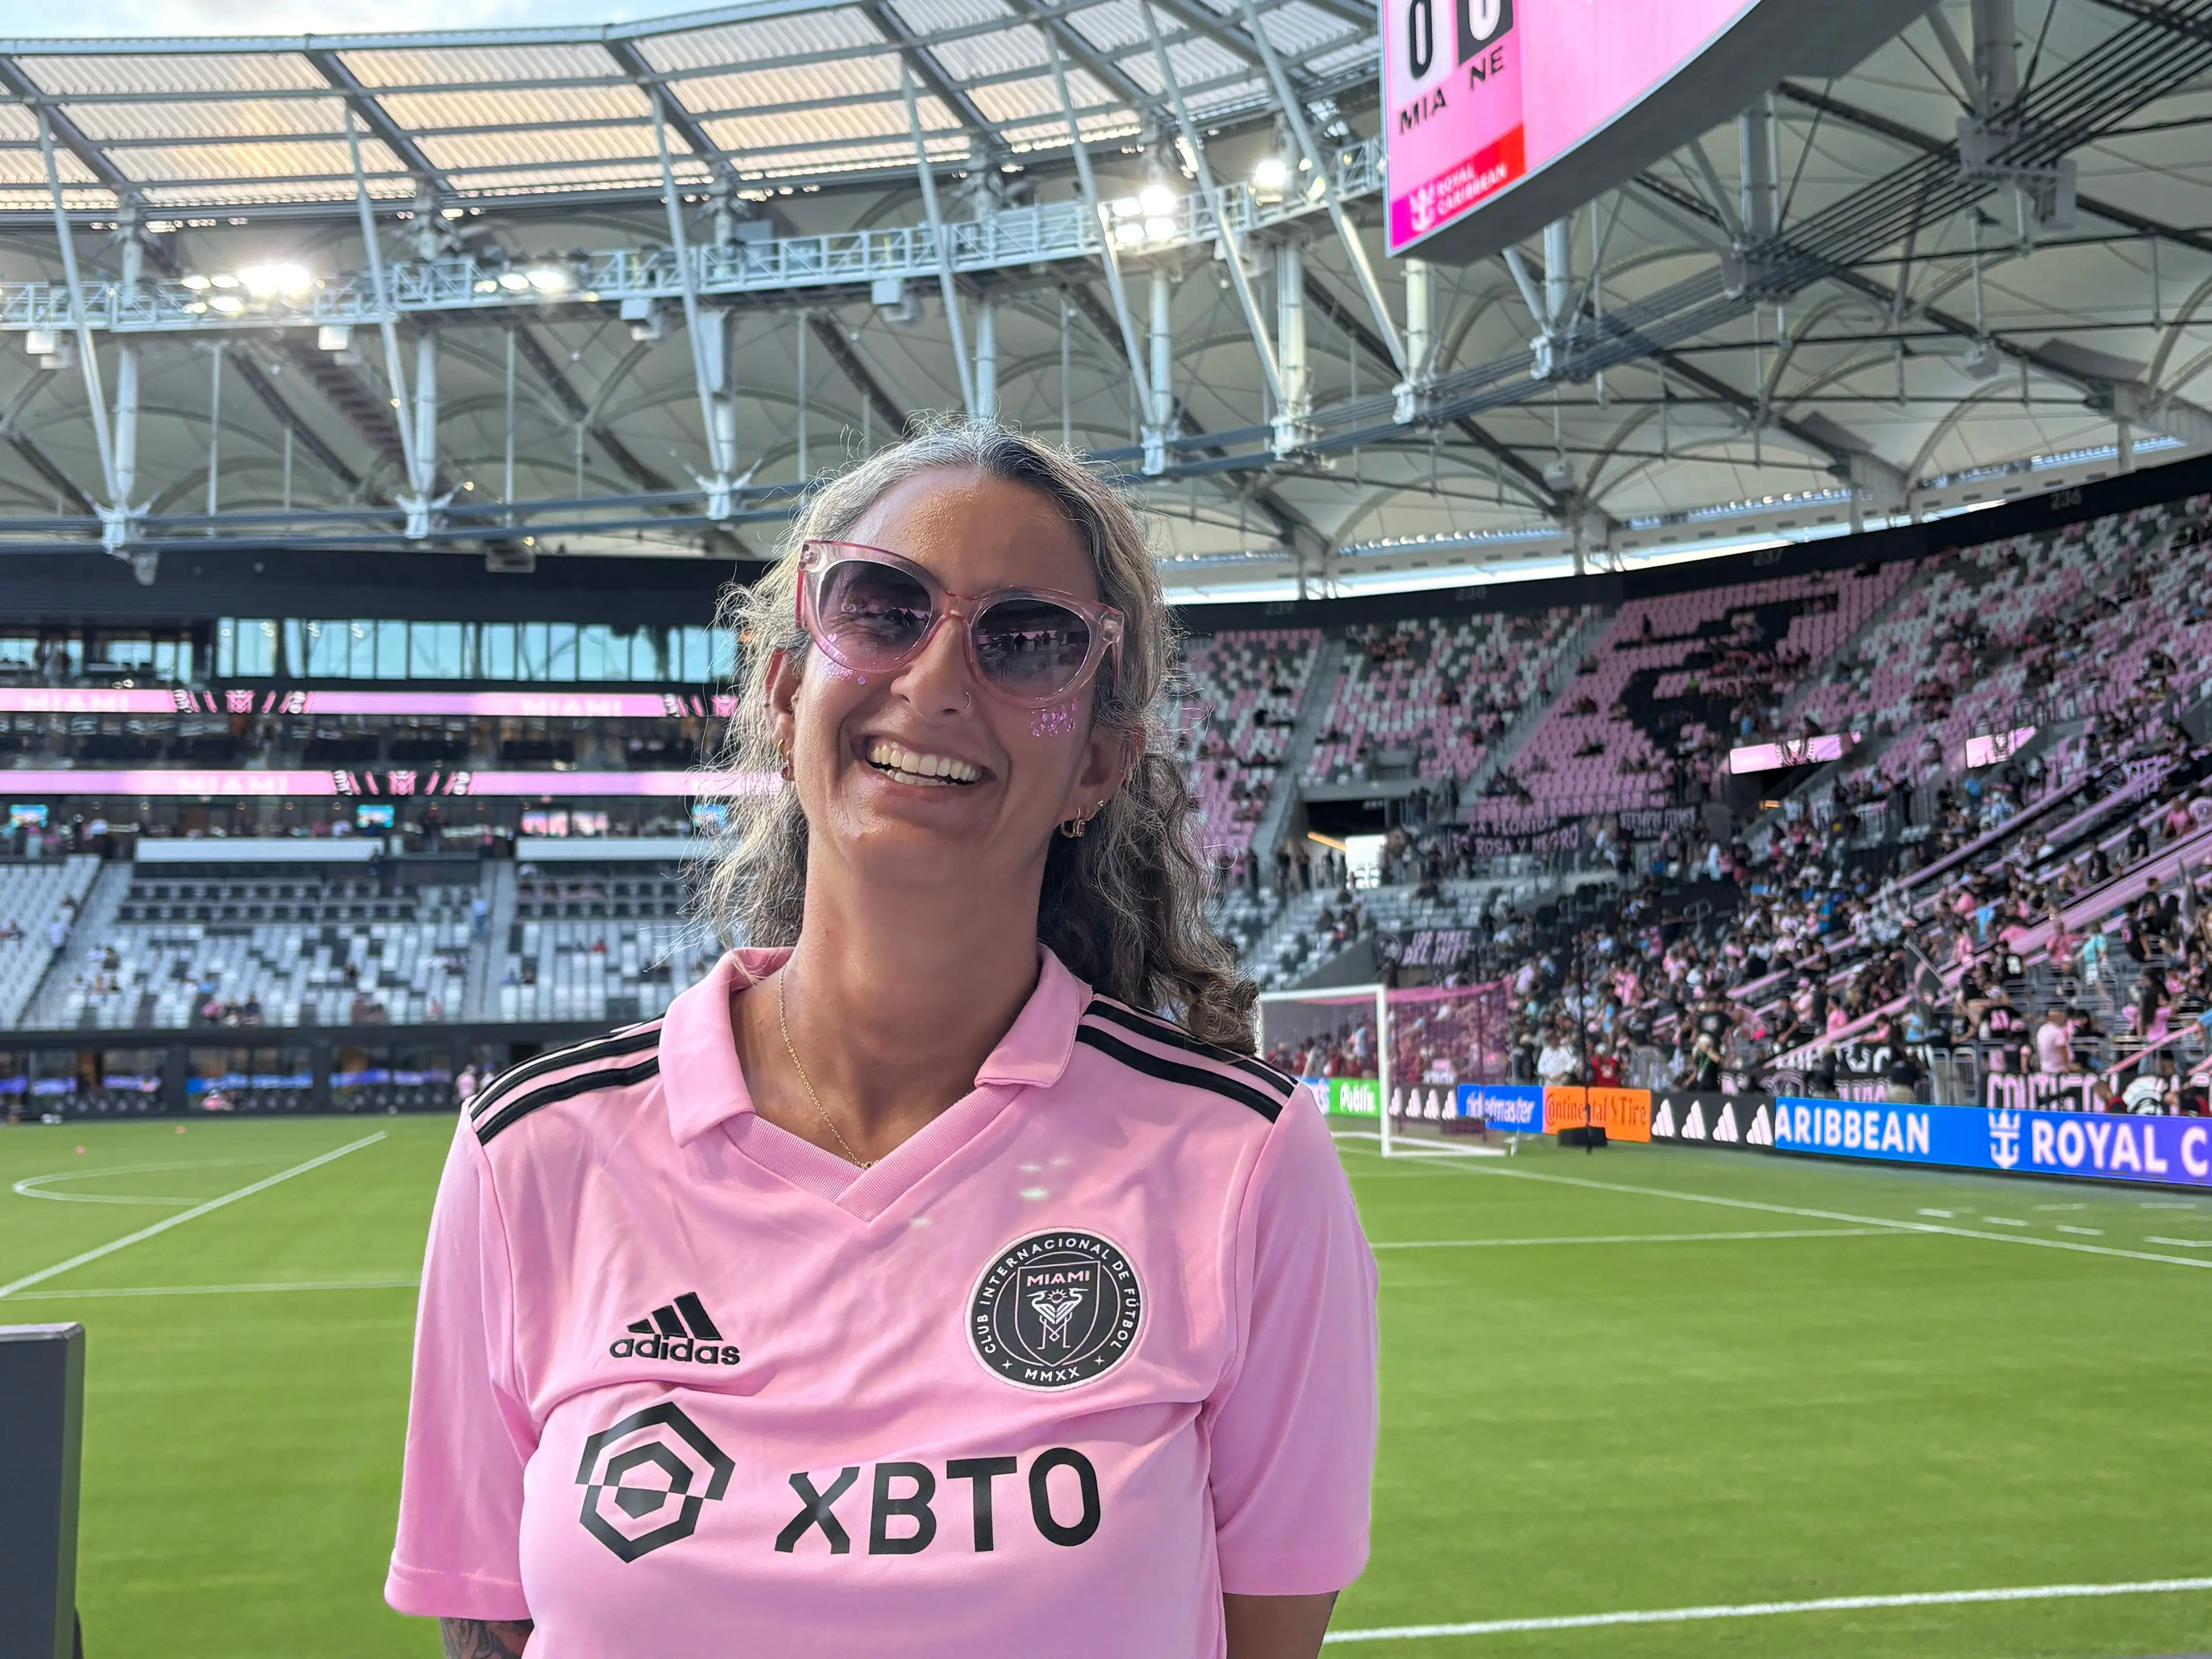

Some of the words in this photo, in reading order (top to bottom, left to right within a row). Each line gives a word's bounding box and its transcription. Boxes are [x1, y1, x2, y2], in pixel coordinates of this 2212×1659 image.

[1409, 0, 1433, 80] 0
[1399, 87, 1447, 135] MIA
[1469, 44, 1505, 92] NE
[1436, 164, 1475, 196] ROYAL
[1437, 161, 1507, 215] CARIBBEAN
[23, 692, 128, 712] MIAMI
[522, 698, 622, 717] MIAMI
[179, 775, 288, 795] MIAMI
[1474, 837, 1512, 855] ROSA
[1619, 1096, 1647, 1127] Tire
[1775, 1103, 1931, 1155] ARIBBEAN
[2031, 1118, 2168, 1174] ROYAL
[979, 1238, 1109, 1305] INTERNACIONAL
[1026, 1270, 1090, 1287] MIAMI
[1112, 1260, 1130, 1281] DE
[976, 1314, 997, 1353] CLUB
[1110, 1288, 1140, 1349] FÚTBOL
[610, 1334, 741, 1366] adidas
[1024, 1366, 1080, 1382] MMXX
[774, 1446, 1101, 1555] XBTO
